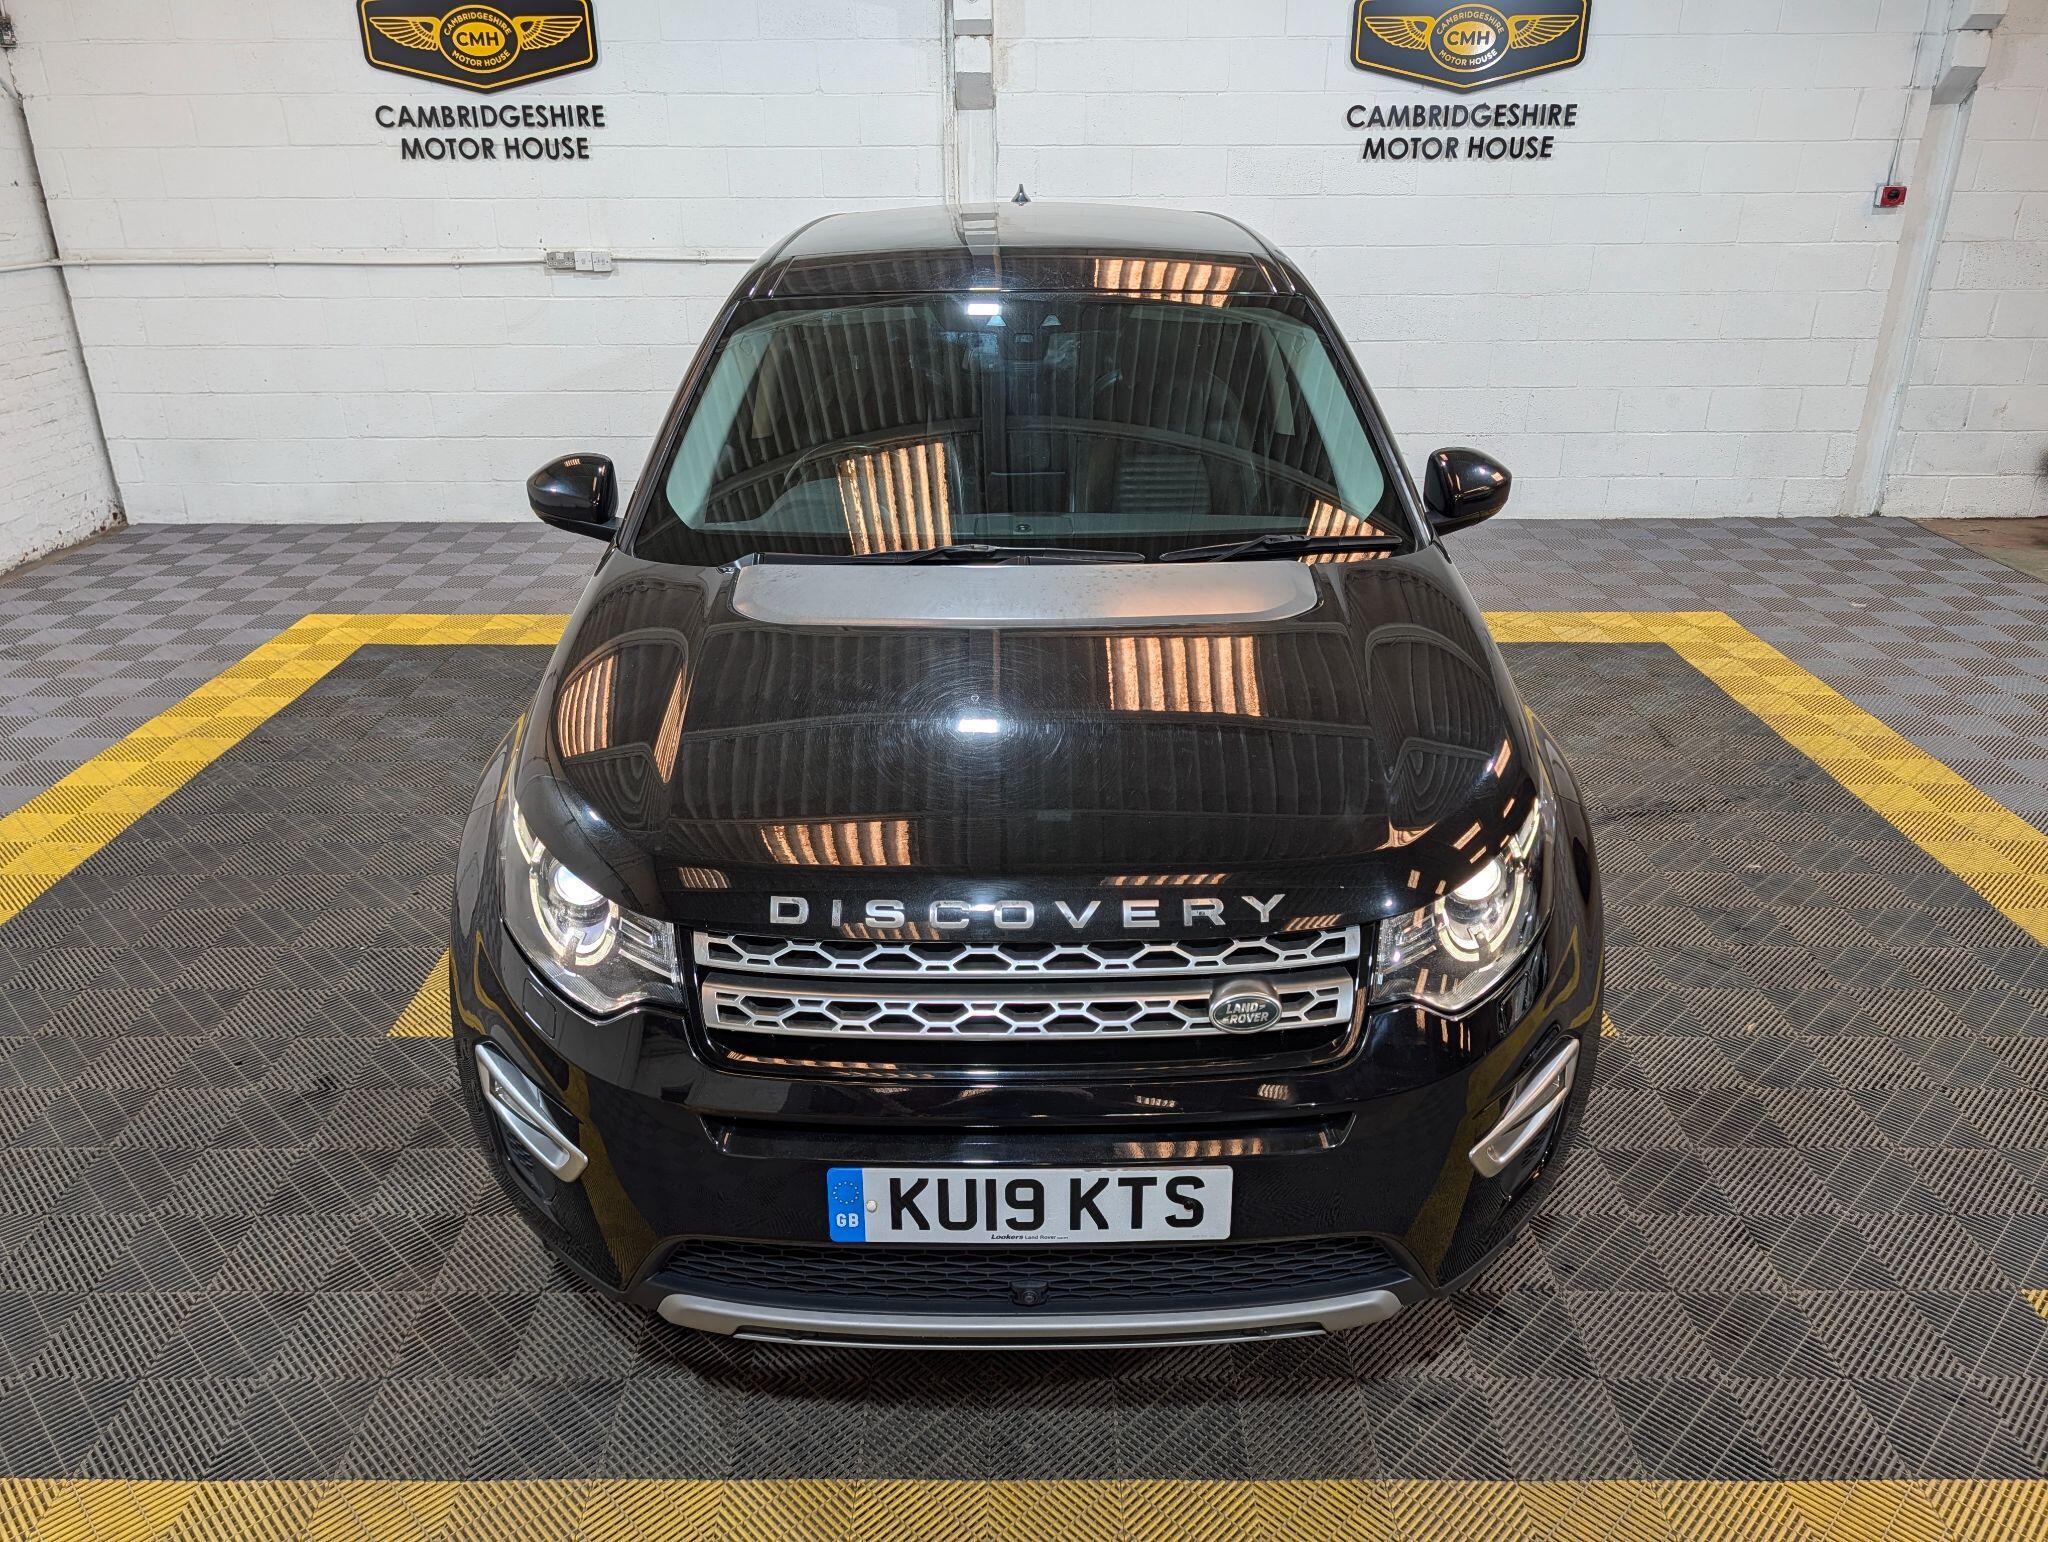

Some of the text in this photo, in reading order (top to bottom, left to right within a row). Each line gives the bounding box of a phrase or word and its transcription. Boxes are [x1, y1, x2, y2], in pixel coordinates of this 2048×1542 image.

[443, 12, 512, 36] CAMBRIDGESHIRE
[1436, 11, 1505, 35] CAMBRIDGESHIRE
[456, 31, 499, 46] CMH
[1446, 30, 1490, 45] CMH
[452, 49, 511, 67] MOTOR HOUSE
[1438, 48, 1498, 66] MOTOR HOUSE
[375, 104, 606, 128] CAMBRIDGESHIRE
[1346, 103, 1578, 128] CAMBRIDGESHIRE
[401, 136, 590, 160] MOTOR HOUSE
[1362, 135, 1555, 160] MOTOR HOUSE
[769, 893, 1286, 930] DISCOVERY
[889, 1175, 1206, 1231] KU19 KTS
[836, 1212, 859, 1228] GB
